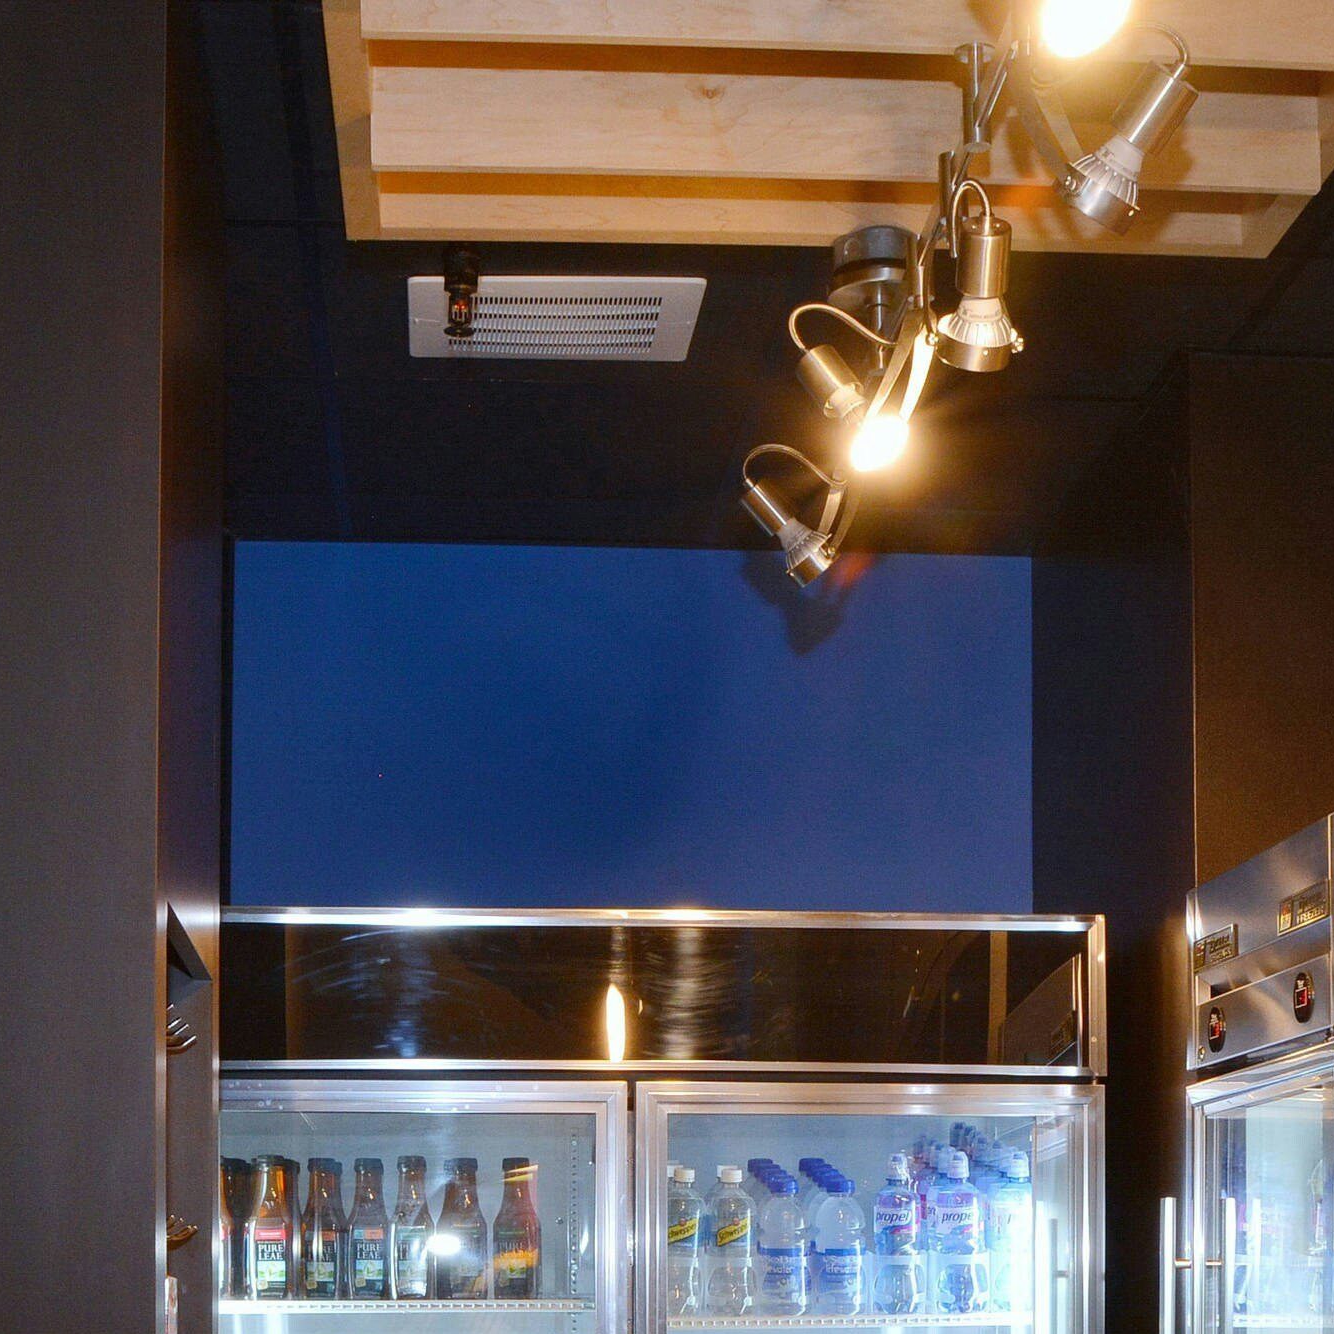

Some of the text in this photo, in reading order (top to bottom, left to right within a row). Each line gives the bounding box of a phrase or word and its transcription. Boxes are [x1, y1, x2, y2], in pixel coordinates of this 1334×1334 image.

[875, 1208, 910, 1224] propel
[941, 1211, 973, 1224] prope
[257, 1243, 284, 1253] PURE
[356, 1242, 383, 1252] PURE
[257, 1251, 284, 1261] LEAF
